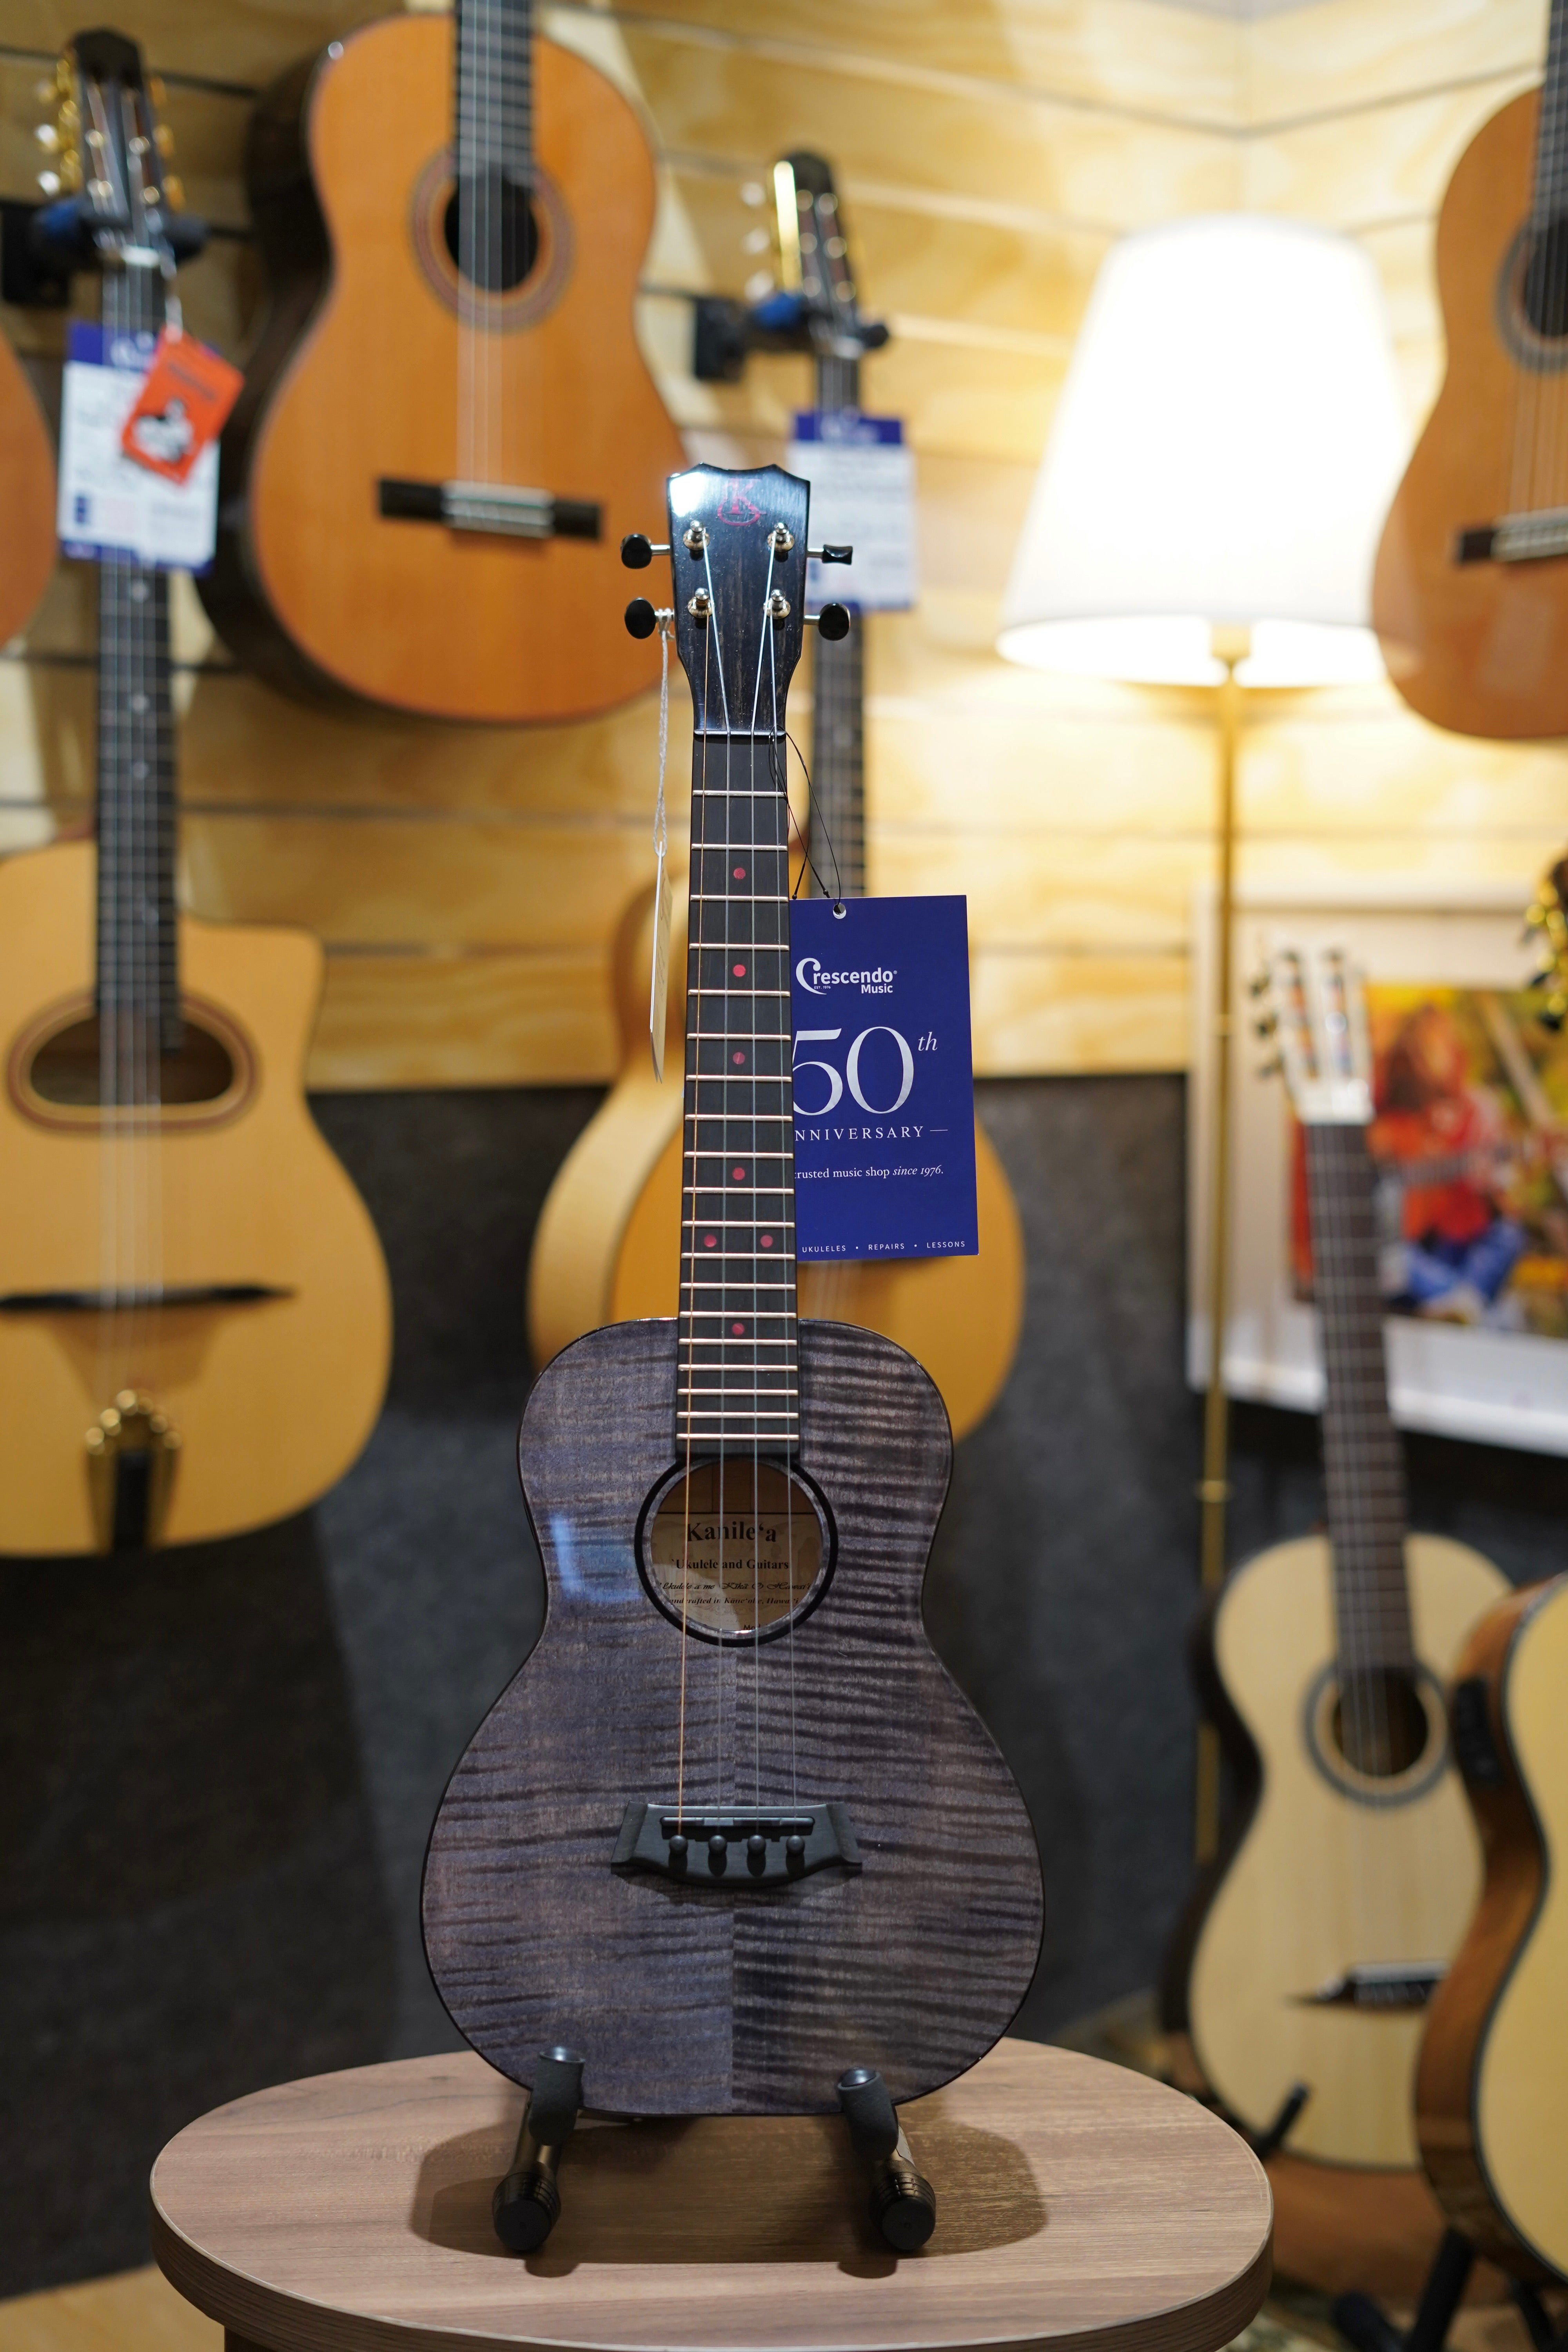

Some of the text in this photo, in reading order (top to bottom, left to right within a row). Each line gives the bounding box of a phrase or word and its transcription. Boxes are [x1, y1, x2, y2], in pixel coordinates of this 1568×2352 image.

[861, 983, 893, 994] Music
[794, 1126, 924, 1141] NNIVERSARY
[833, 1167, 862, 1178] music
[866, 1166, 890, 1179] shop
[893, 1166, 917, 1176] since
[920, 1165, 944, 1177] 1976.
[722, 1559, 742, 1569] and
[746, 1559, 789, 1569] Guitars
